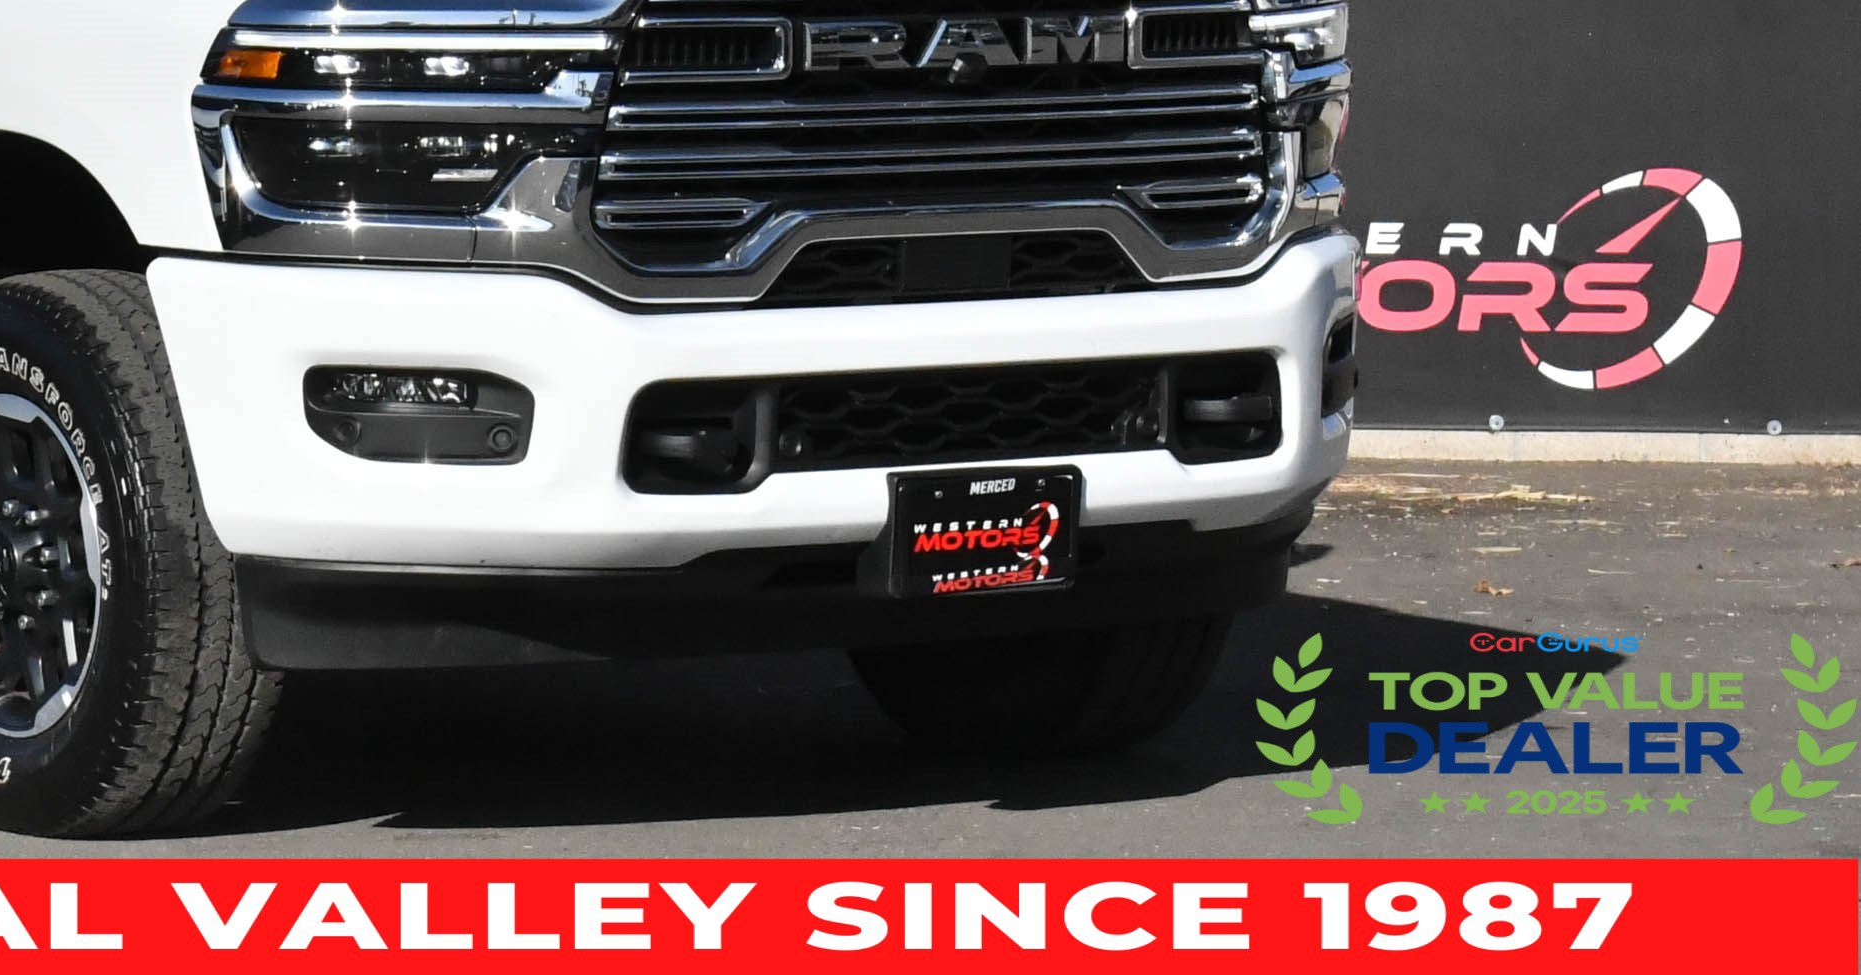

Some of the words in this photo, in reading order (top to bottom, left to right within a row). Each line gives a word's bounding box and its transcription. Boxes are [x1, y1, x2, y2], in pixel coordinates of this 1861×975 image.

[802, 16, 1126, 72] RAM
[969, 477, 1017, 496] MERCED
[913, 517, 1024, 534] WESTERN
[913, 524, 1042, 553] MOTORS
